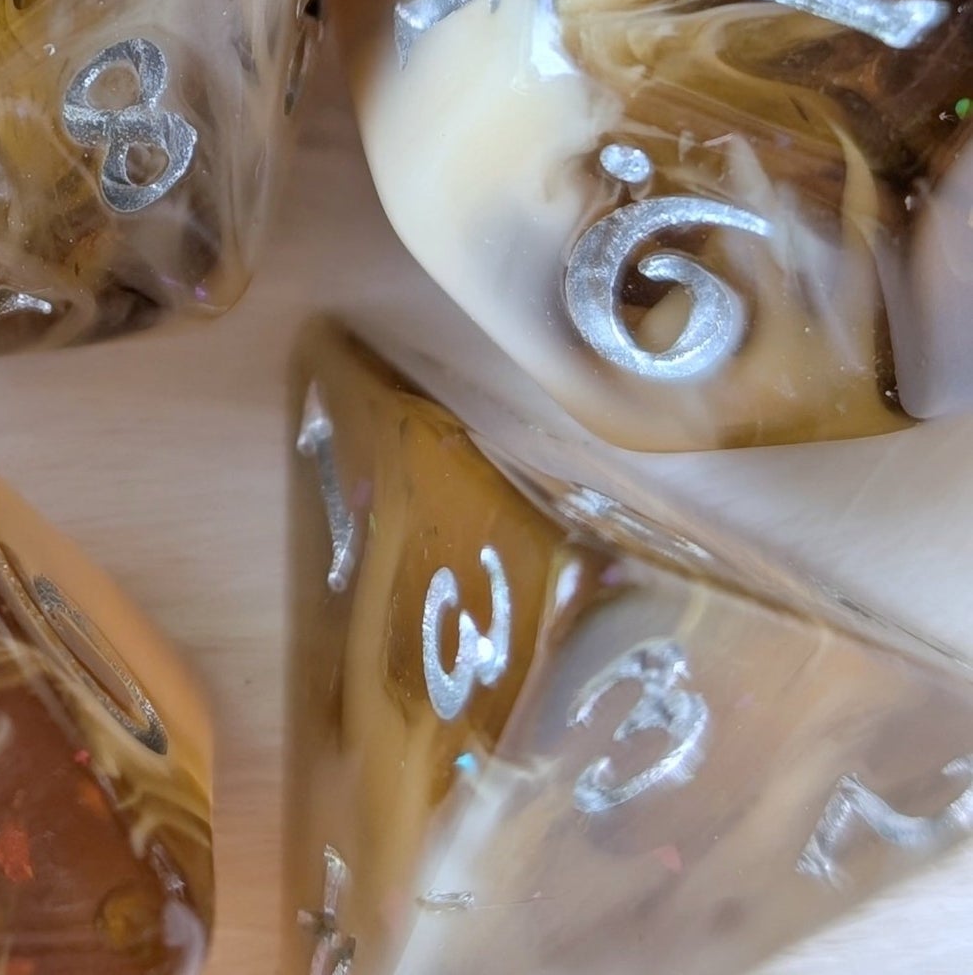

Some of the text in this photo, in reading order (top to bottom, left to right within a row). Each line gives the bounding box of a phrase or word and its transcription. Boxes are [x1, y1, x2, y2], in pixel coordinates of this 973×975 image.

[63, 36, 198, 214] 8
[421, 542, 513, 721] 3
[565, 632, 712, 816] 3
